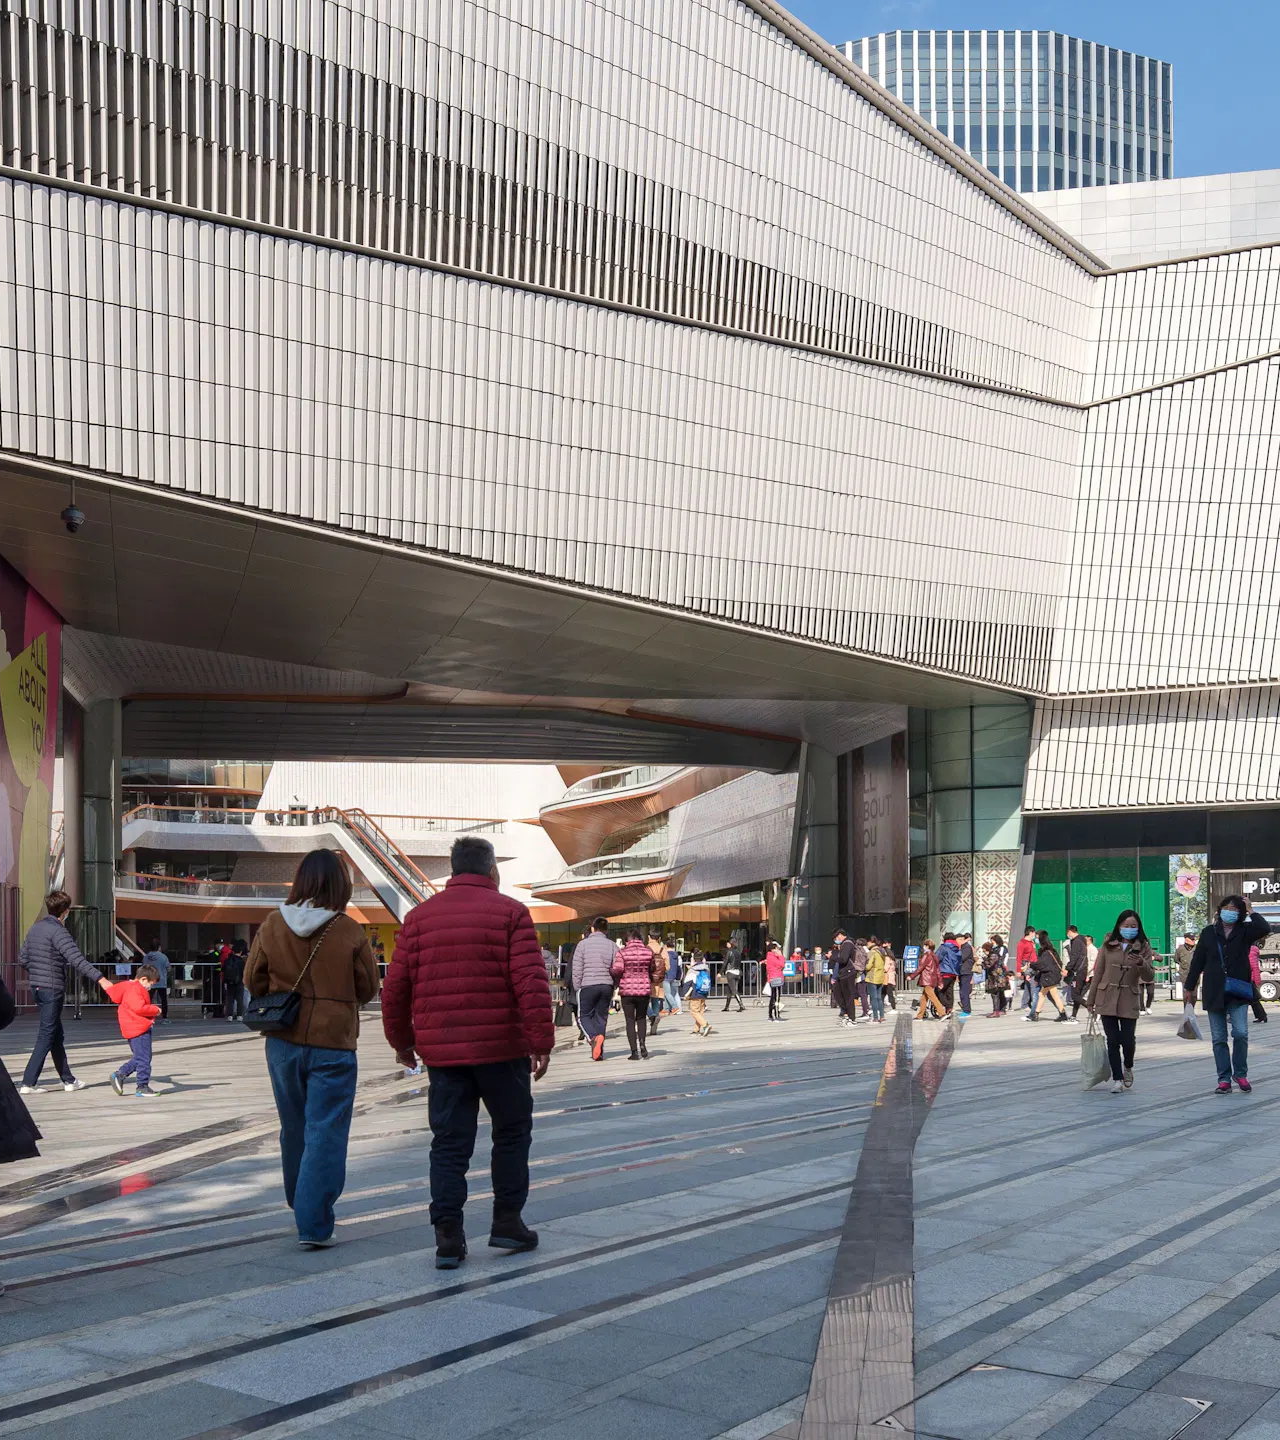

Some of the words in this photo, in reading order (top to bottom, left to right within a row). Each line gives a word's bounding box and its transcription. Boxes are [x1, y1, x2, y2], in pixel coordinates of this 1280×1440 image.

[30, 636, 47, 677] ALL
[18, 666, 47, 717] ABOUT
[863, 794, 892, 822] BOUT
